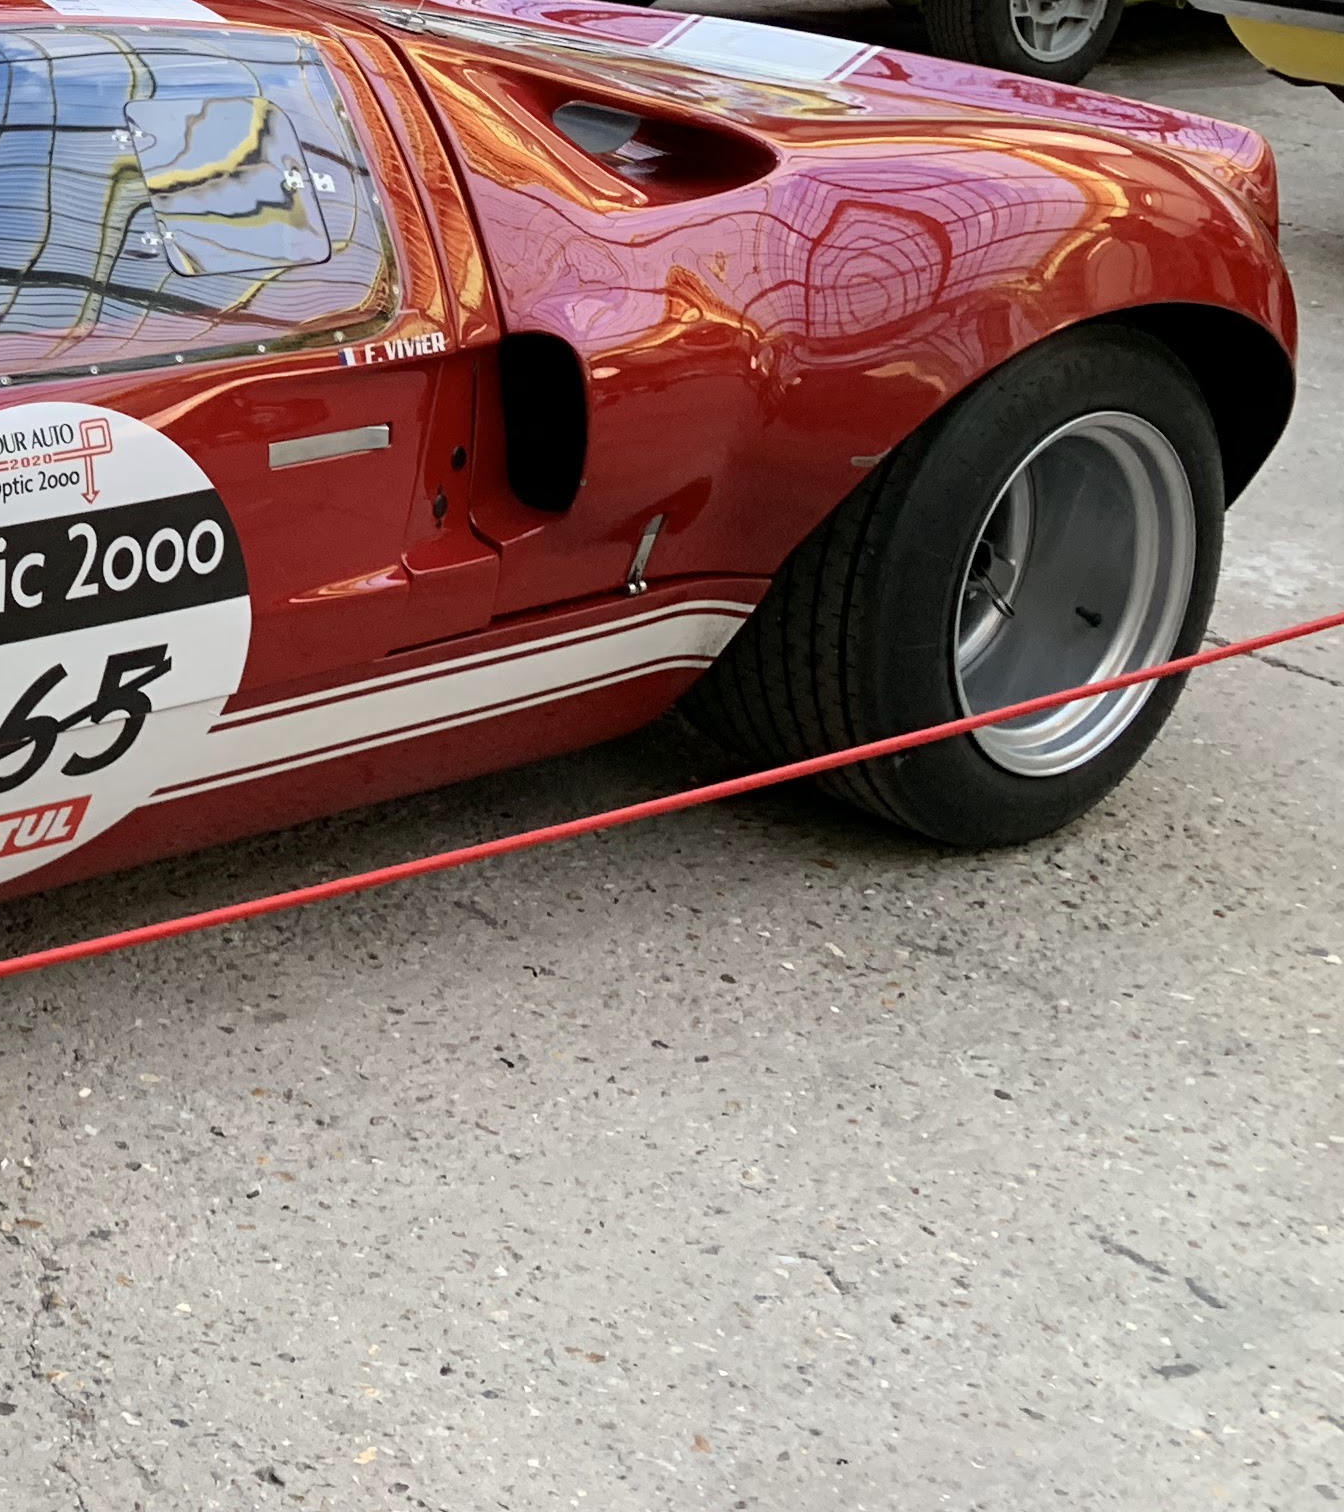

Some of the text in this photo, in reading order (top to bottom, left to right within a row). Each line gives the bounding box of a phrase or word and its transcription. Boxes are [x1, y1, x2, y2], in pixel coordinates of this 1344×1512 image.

[365, 332, 446, 364] F. VIVIER
[31, 423, 75, 448] AUTO
[9, 454, 53, 469] 2020
[38, 469, 81, 491] 2000
[64, 519, 226, 601] 2000
